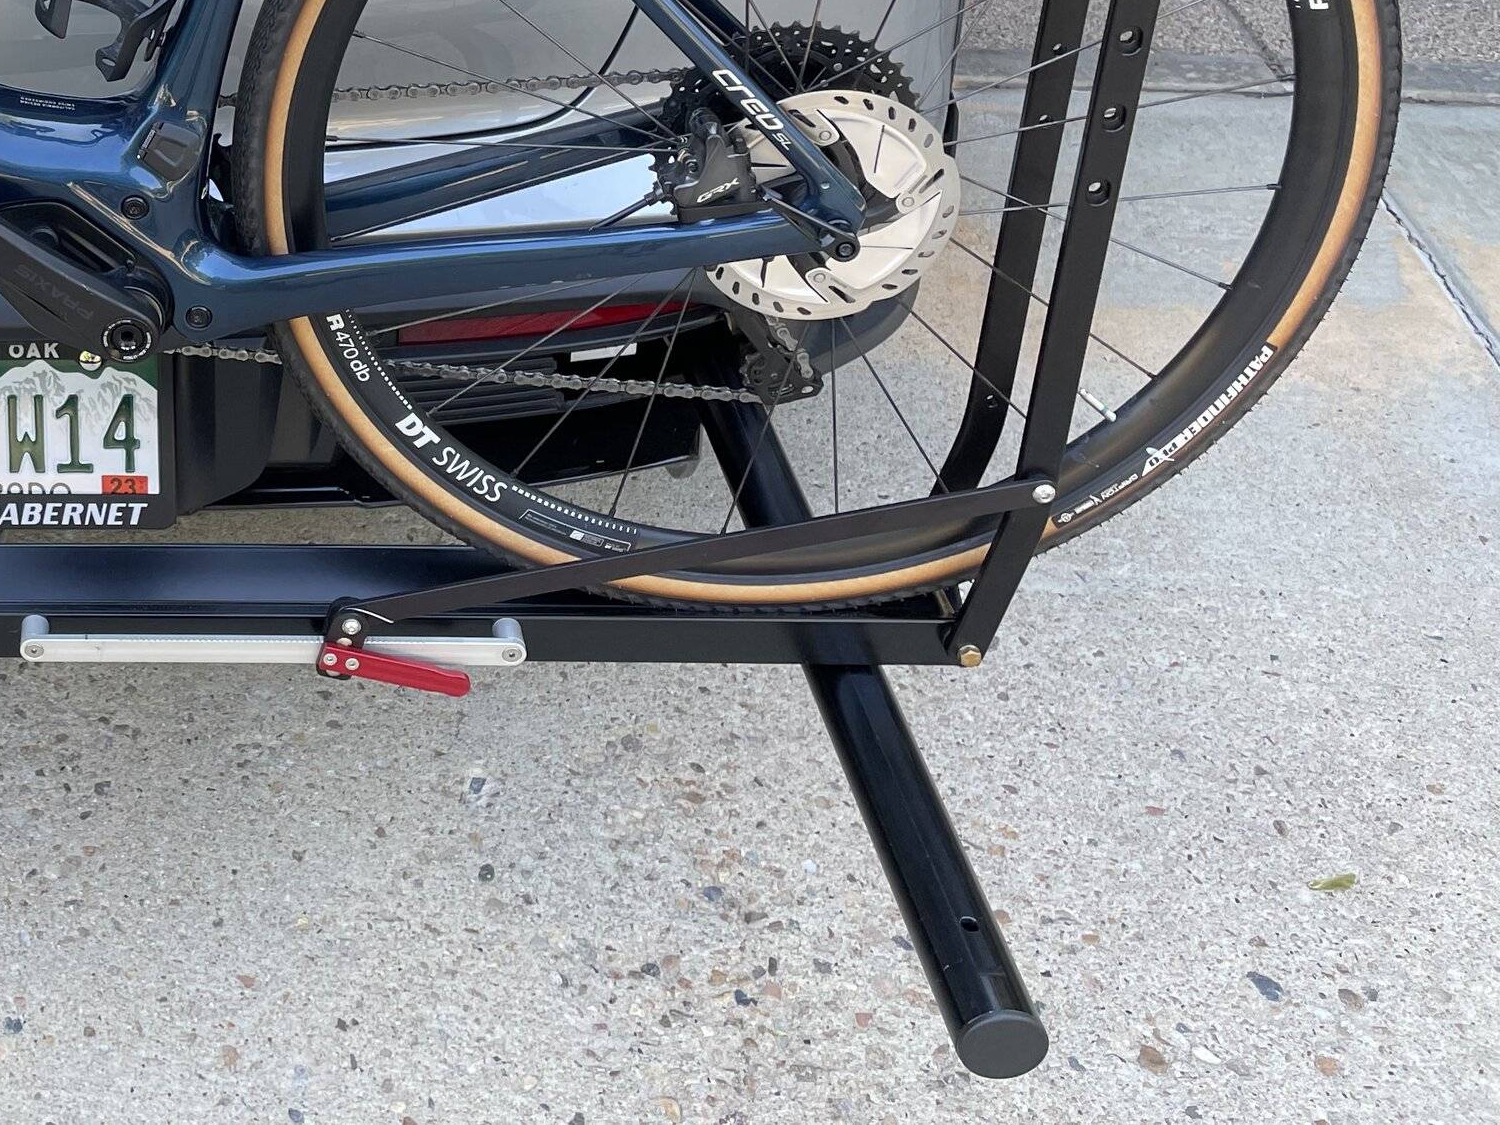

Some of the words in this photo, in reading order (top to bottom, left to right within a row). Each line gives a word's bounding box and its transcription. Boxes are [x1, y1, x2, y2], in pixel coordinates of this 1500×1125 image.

[772, 132, 792, 151] SL
[696, 177, 740, 203] GRX
[8, 342, 60, 360] OAK
[1181, 345, 1274, 442] PATHFINDER
[395, 412, 441, 449] DT
[432, 446, 508, 502] SWISS
